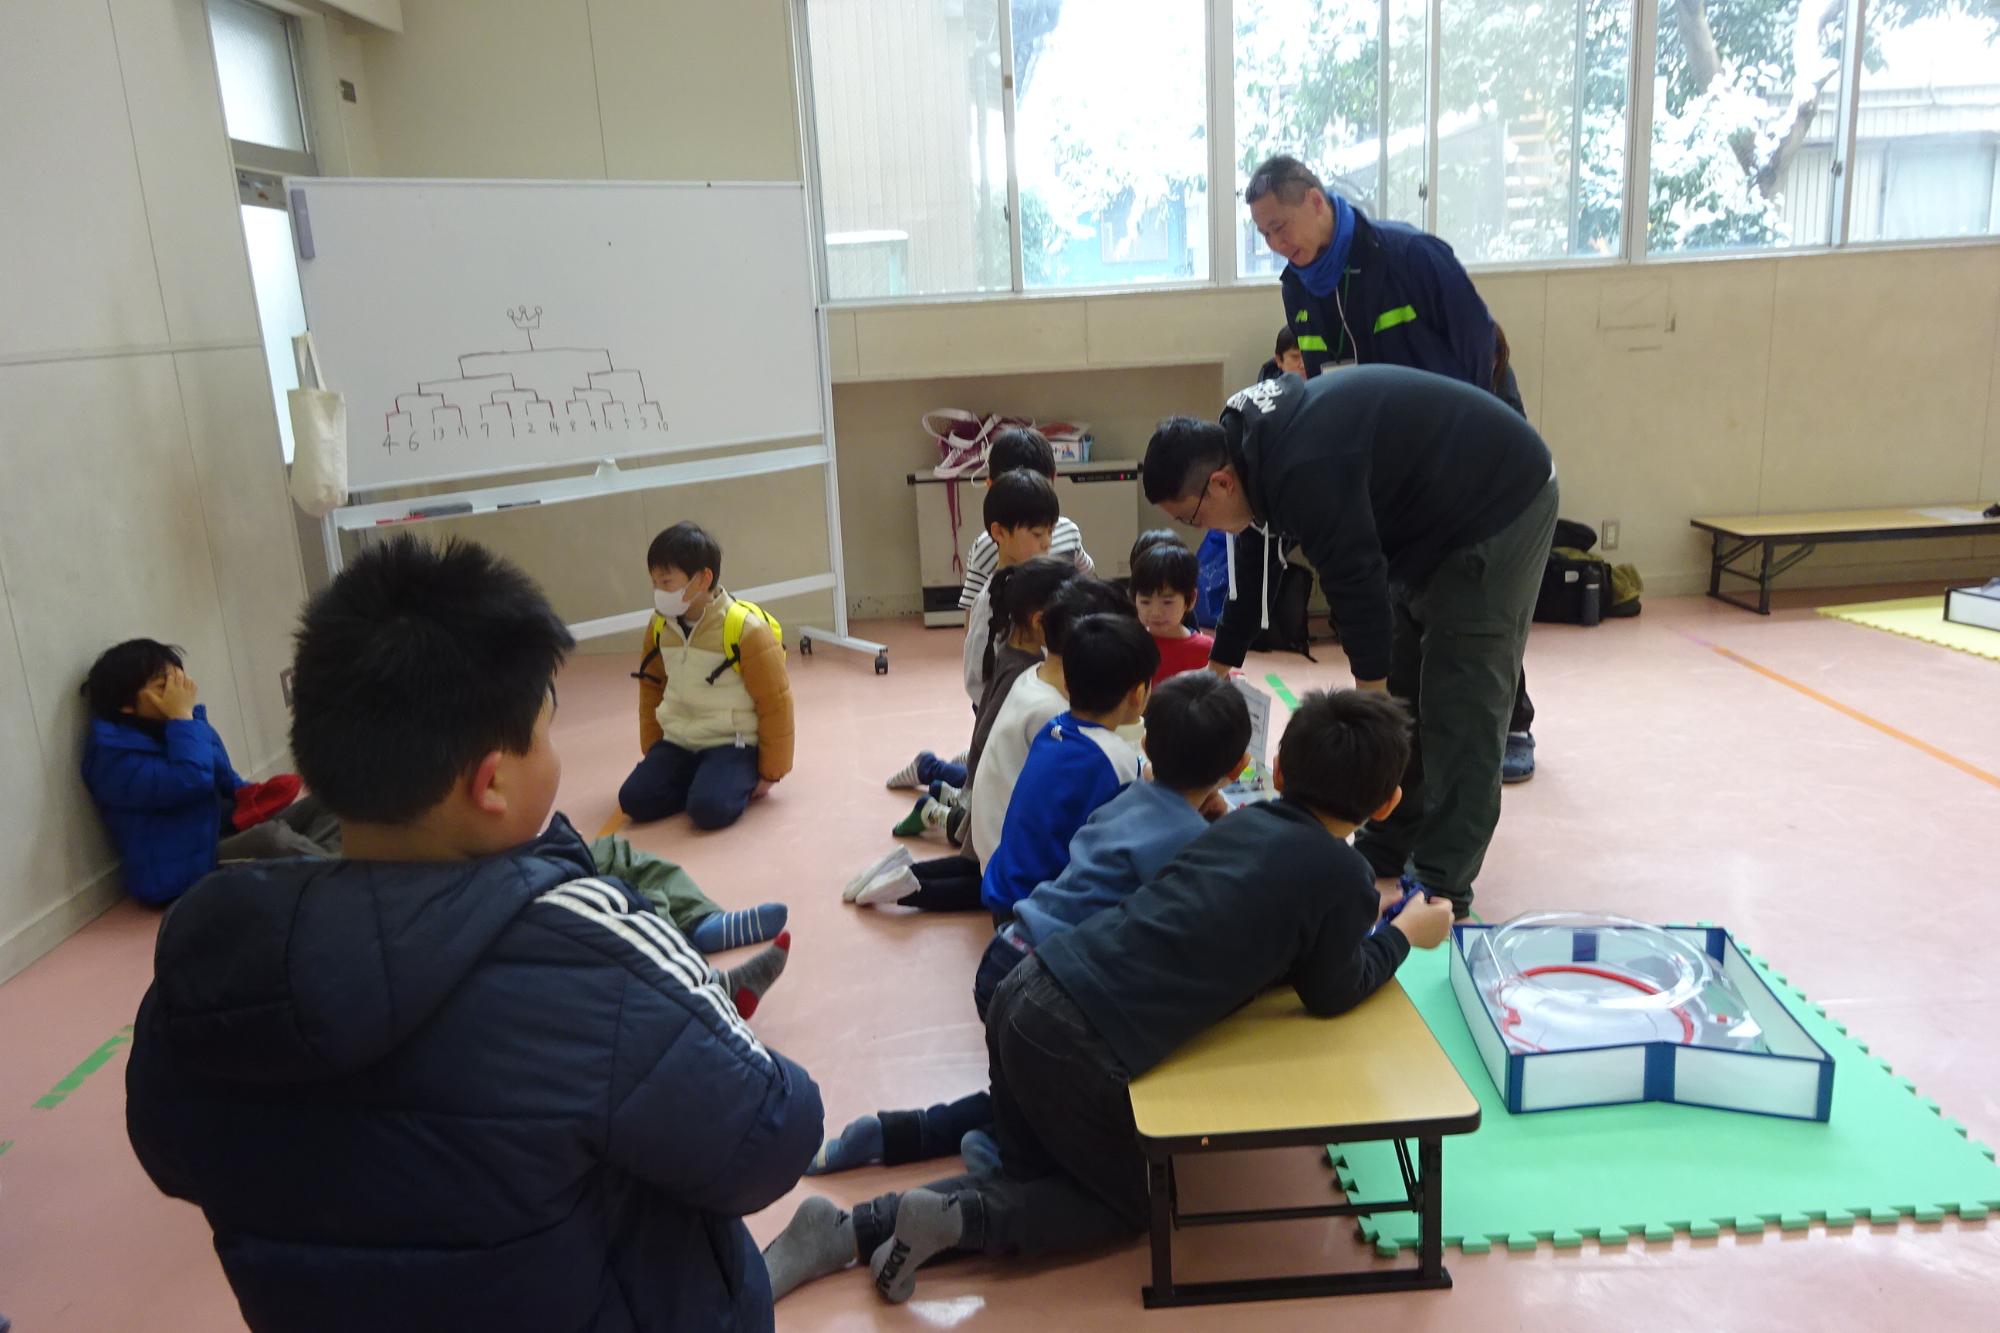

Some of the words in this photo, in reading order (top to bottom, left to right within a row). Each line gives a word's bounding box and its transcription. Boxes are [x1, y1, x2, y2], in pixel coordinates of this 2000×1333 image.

[382, 432, 400, 457] 4
[408, 430, 420, 452] 6
[480, 422, 489, 439] 7
[527, 422, 536, 434] 2
[549, 421, 559, 436] 14
[657, 420, 669, 432] 10
